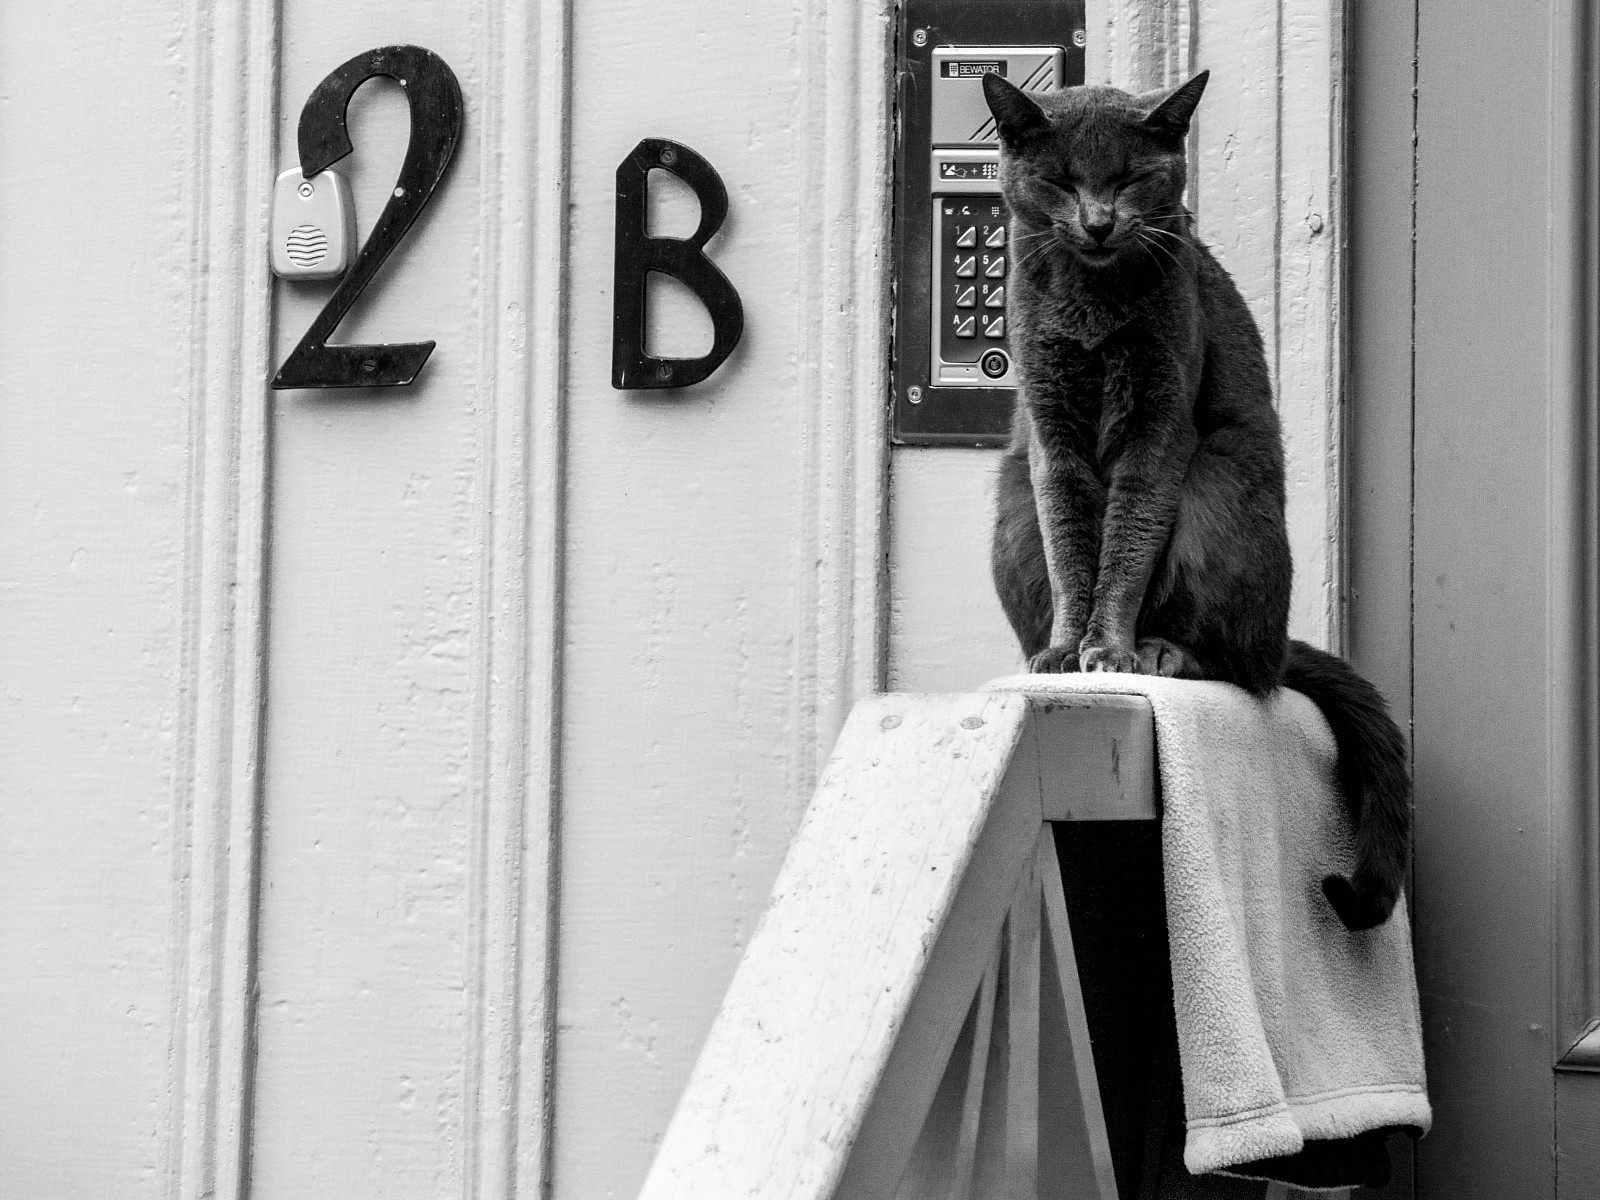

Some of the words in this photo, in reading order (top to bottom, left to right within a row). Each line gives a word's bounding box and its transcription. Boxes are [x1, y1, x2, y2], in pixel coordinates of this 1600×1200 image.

[959, 65, 1000, 74] BEWATOR
[270, 44, 463, 389] 2
[612, 137, 744, 390] B
[954, 224, 960, 235] 1
[983, 224, 990, 235] 2
[954, 254, 961, 265] 4
[983, 254, 989, 265] 5
[954, 284, 961, 294] 7
[982, 284, 989, 294] 8
[953, 314, 961, 325] A
[982, 314, 989, 325] 0
